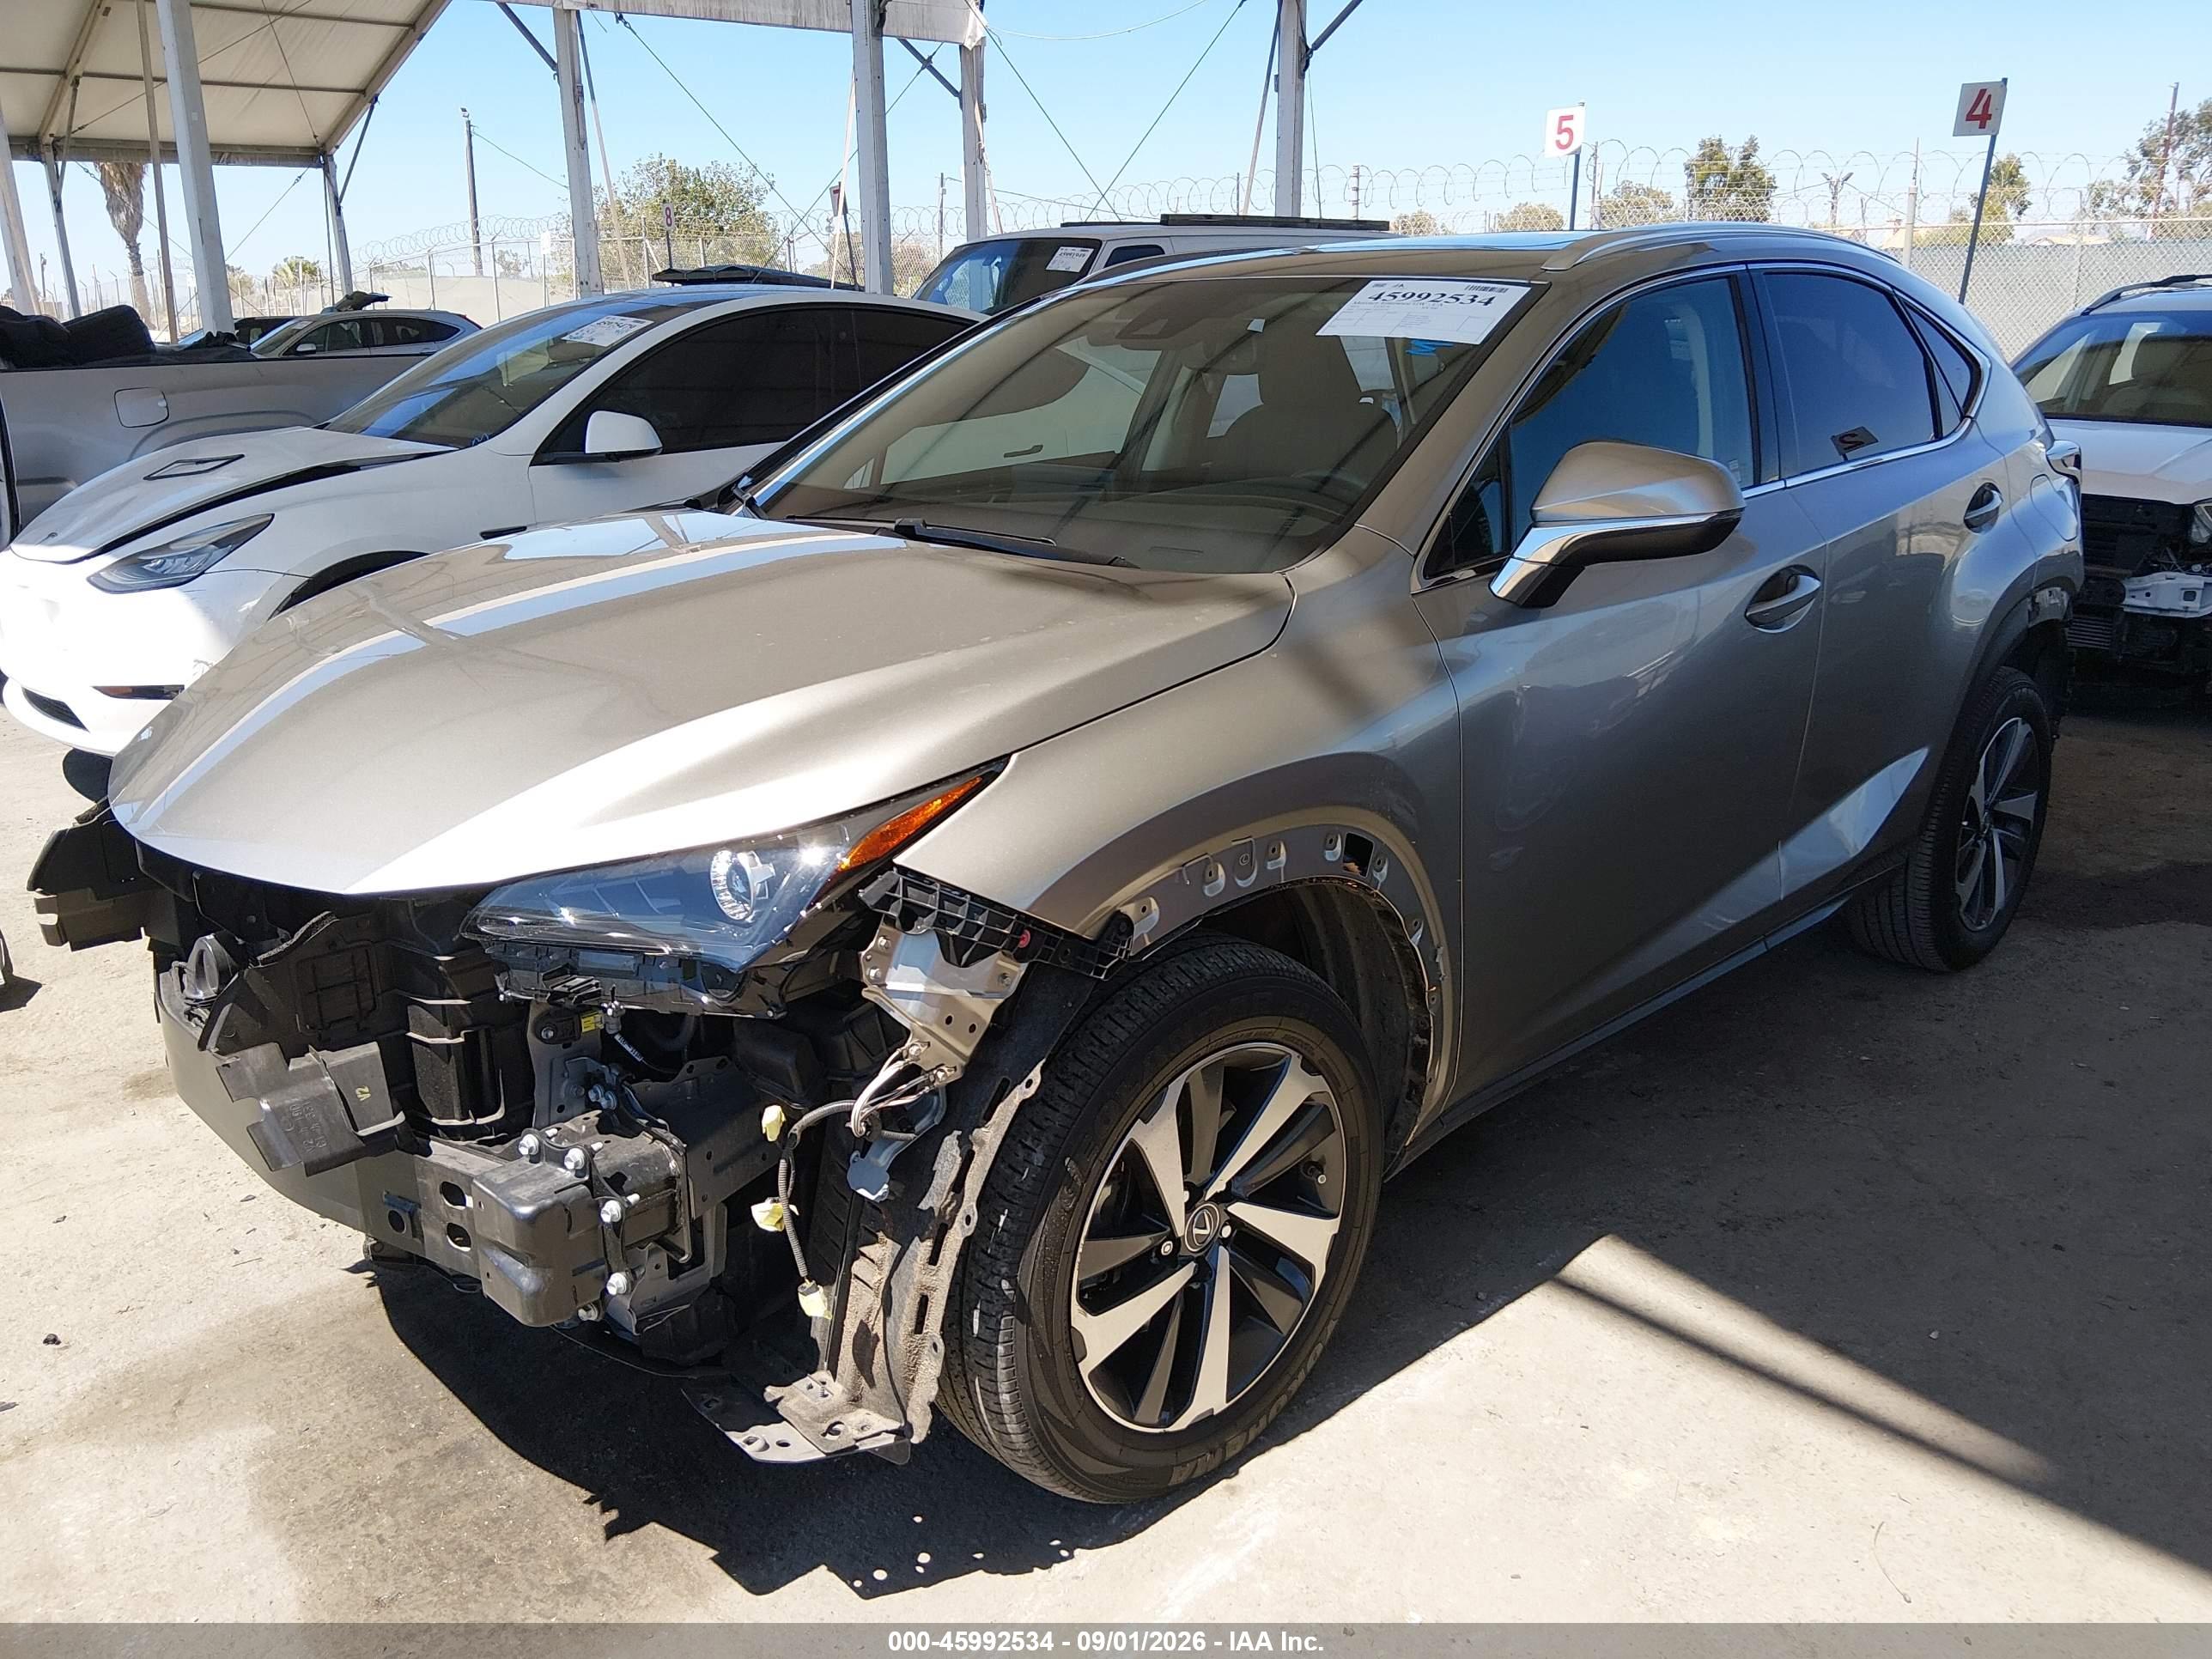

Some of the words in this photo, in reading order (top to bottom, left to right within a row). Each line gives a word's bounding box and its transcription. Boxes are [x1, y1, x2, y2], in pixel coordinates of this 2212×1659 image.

[1965, 88, 1992, 129] 4
[1554, 114, 1574, 150] 5
[665, 206, 672, 227] 8
[1367, 290, 1496, 307] 45992534
